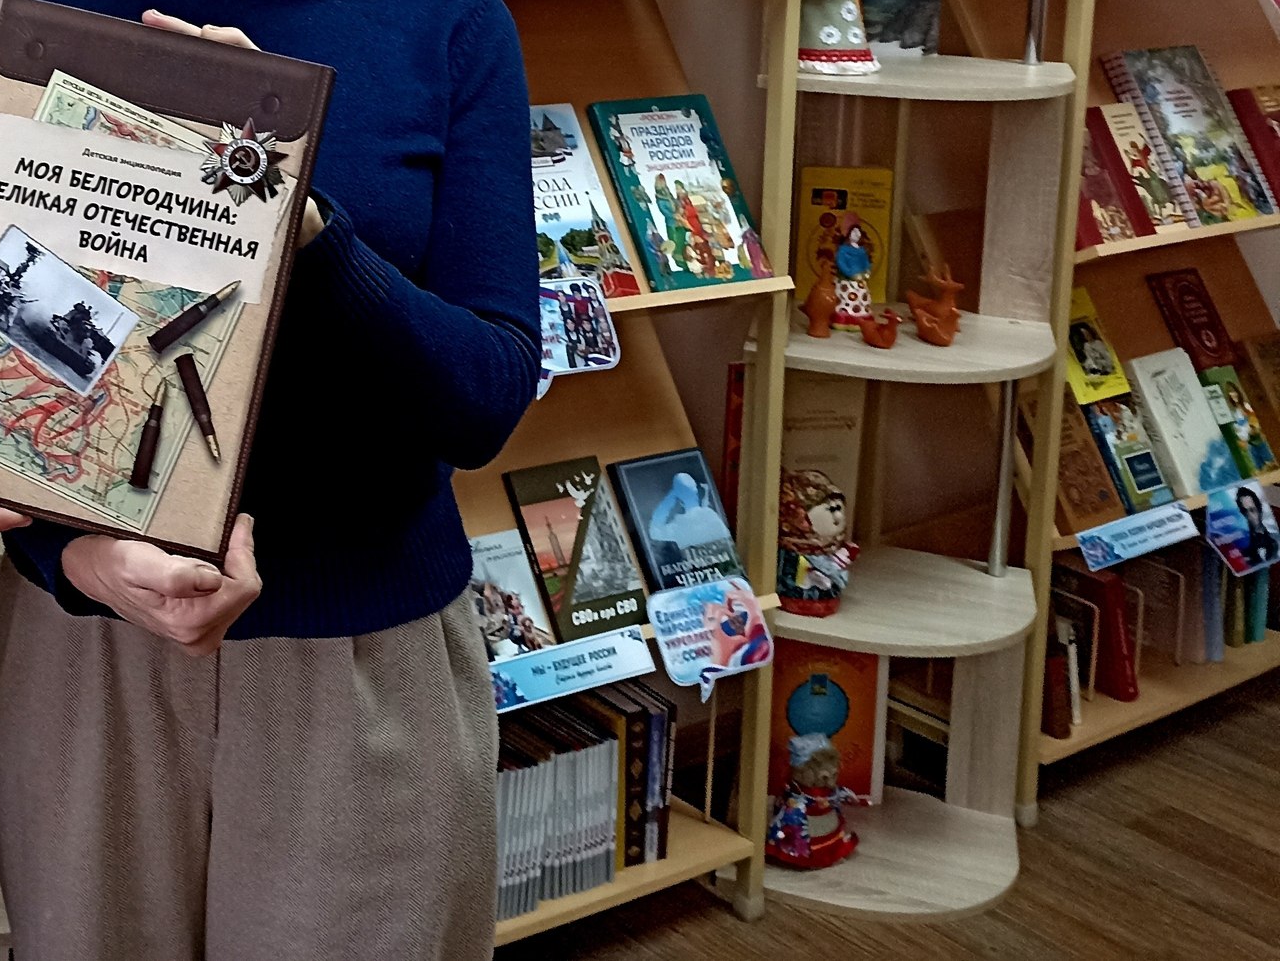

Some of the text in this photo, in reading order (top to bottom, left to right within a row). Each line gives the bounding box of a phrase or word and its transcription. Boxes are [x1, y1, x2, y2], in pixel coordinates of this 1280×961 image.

[630, 123, 696, 137] ПРАЗДНИКИ
[641, 135, 693, 149] НАРОДОВ
[82, 146, 182, 178] Детская энциклопедия
[648, 148, 695, 161] РОССИИ
[14, 157, 238, 226] МОЯ БЕЛГОРОДЧИНА:
[534, 177, 572, 192] ОДА
[534, 193, 580, 210] ССИИ
[83, 203, 260, 260] ОТЕЧЕСТВЕННАЯ
[78, 229, 148, 263] ВОЙНА
[675, 567, 725, 587] ЧЕРТА
